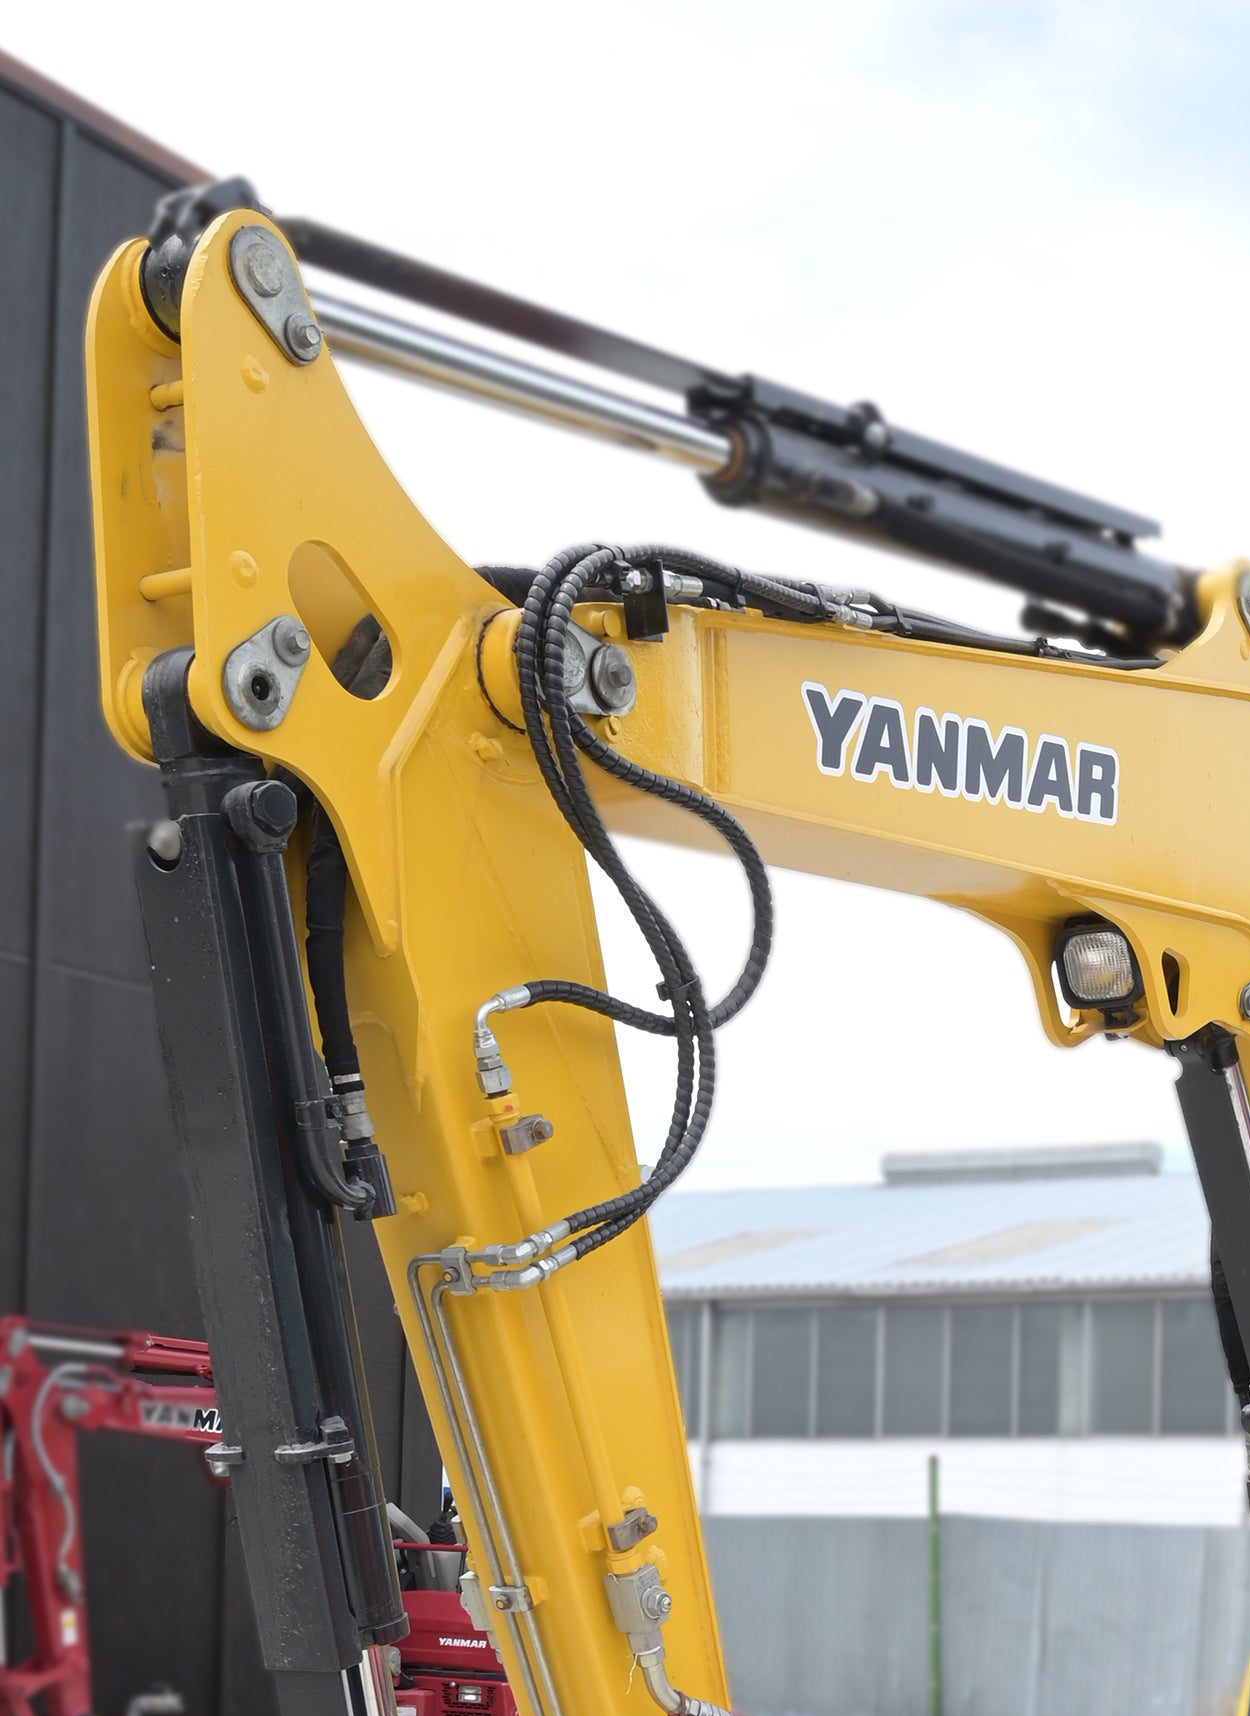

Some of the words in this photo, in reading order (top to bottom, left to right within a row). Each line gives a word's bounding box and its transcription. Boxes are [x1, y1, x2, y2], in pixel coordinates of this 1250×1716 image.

[804, 686, 1117, 822] YANMAR
[140, 1401, 222, 1432] YANM
[439, 1637, 487, 1649] YANMAR
